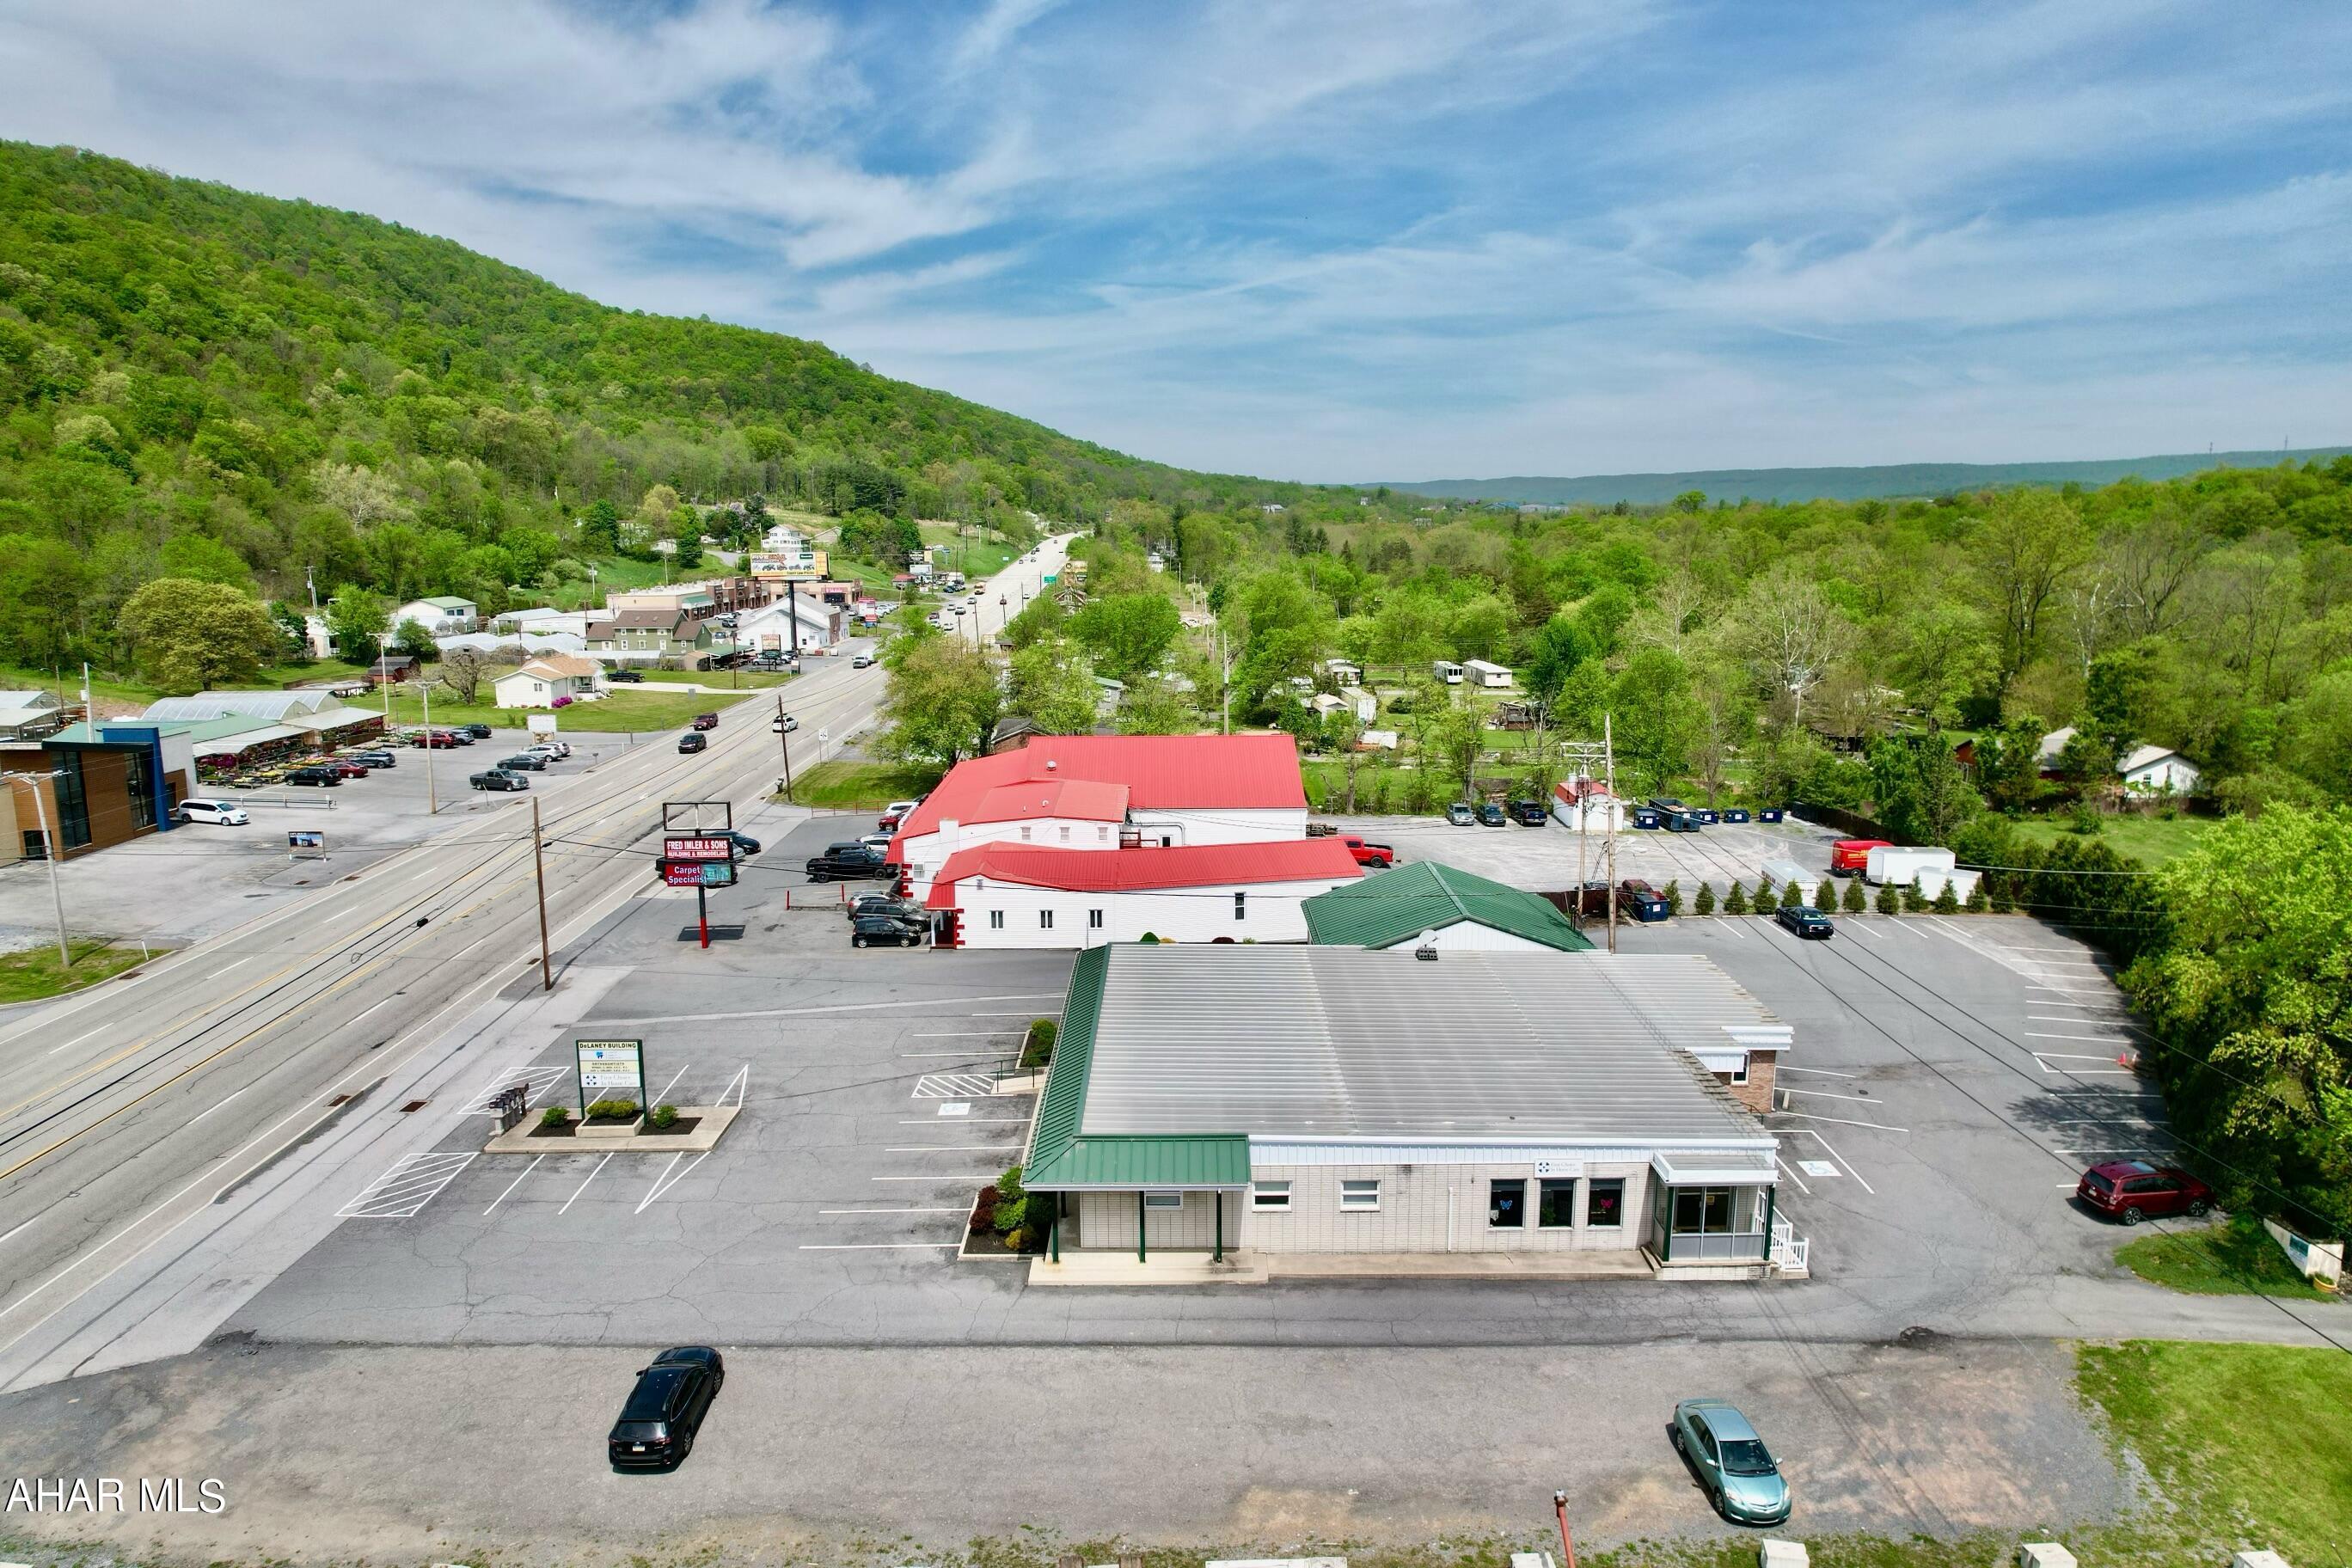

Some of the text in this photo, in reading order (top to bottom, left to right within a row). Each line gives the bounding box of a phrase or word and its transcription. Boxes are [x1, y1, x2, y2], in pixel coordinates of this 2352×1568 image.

[667, 840, 728, 850] FRED IMLER & SONS
[674, 866, 701, 875] Carpet
[668, 875, 707, 885] Specialist
